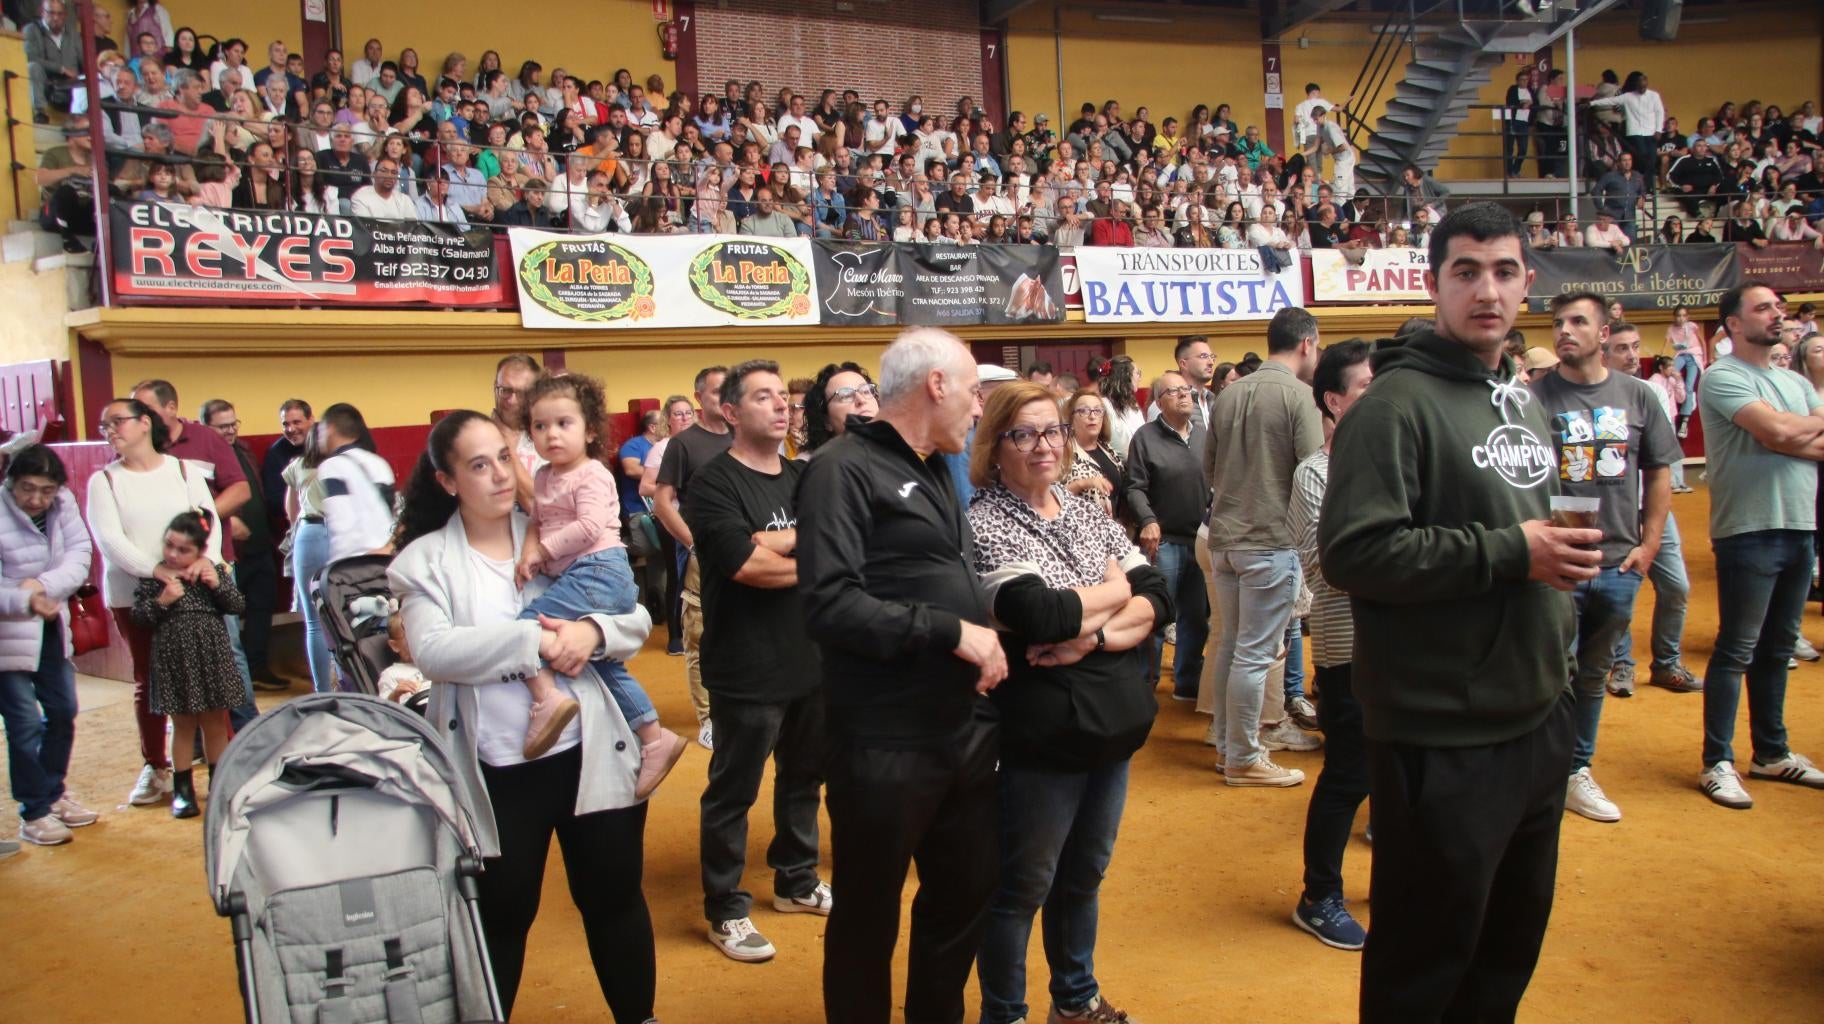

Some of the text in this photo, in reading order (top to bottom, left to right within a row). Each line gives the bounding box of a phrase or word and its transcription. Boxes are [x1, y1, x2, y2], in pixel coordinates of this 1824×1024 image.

[680, 16, 690, 32] 7
[987, 44, 996, 59] 7
[1267, 57, 1276, 71] 7
[1538, 59, 1547, 72] 6
[131, 204, 353, 238] ELECTRICIDAD
[397, 232, 444, 245] Peñaranda
[131, 226, 356, 283] REYES
[373, 243, 490, 259] Alba de Tormes (Salamanca)
[561, 242, 606, 253] FRUTAS
[727, 244, 769, 255] FRUTAS
[935, 252, 977, 260] RESTAURANTE
[1117, 252, 1260, 272] TRANSPORTES
[1616, 247, 1652, 274] AB
[373, 262, 489, 280] Telf 92337 04 30
[546, 257, 632, 285] La Perla
[712, 260, 790, 285] La Perla
[843, 267, 868, 283] Casa
[949, 264, 962, 272] BAR
[136, 278, 283, 291] www.electricidadreyes.com
[930, 275, 939, 283] DE
[939, 274, 975, 283] DESCANSO
[976, 274, 1000, 282] PRIVADA
[1063, 268, 1075, 292] 7
[1561, 272, 1706, 295] aromas de ibérico
[847, 288, 875, 298] Mesón
[912, 297, 928, 305] CTRA
[1085, 279, 1293, 317] BAUTISTA
[1656, 292, 1723, 307] 615 307 70
[1471, 444, 1557, 469] CHAMPION
